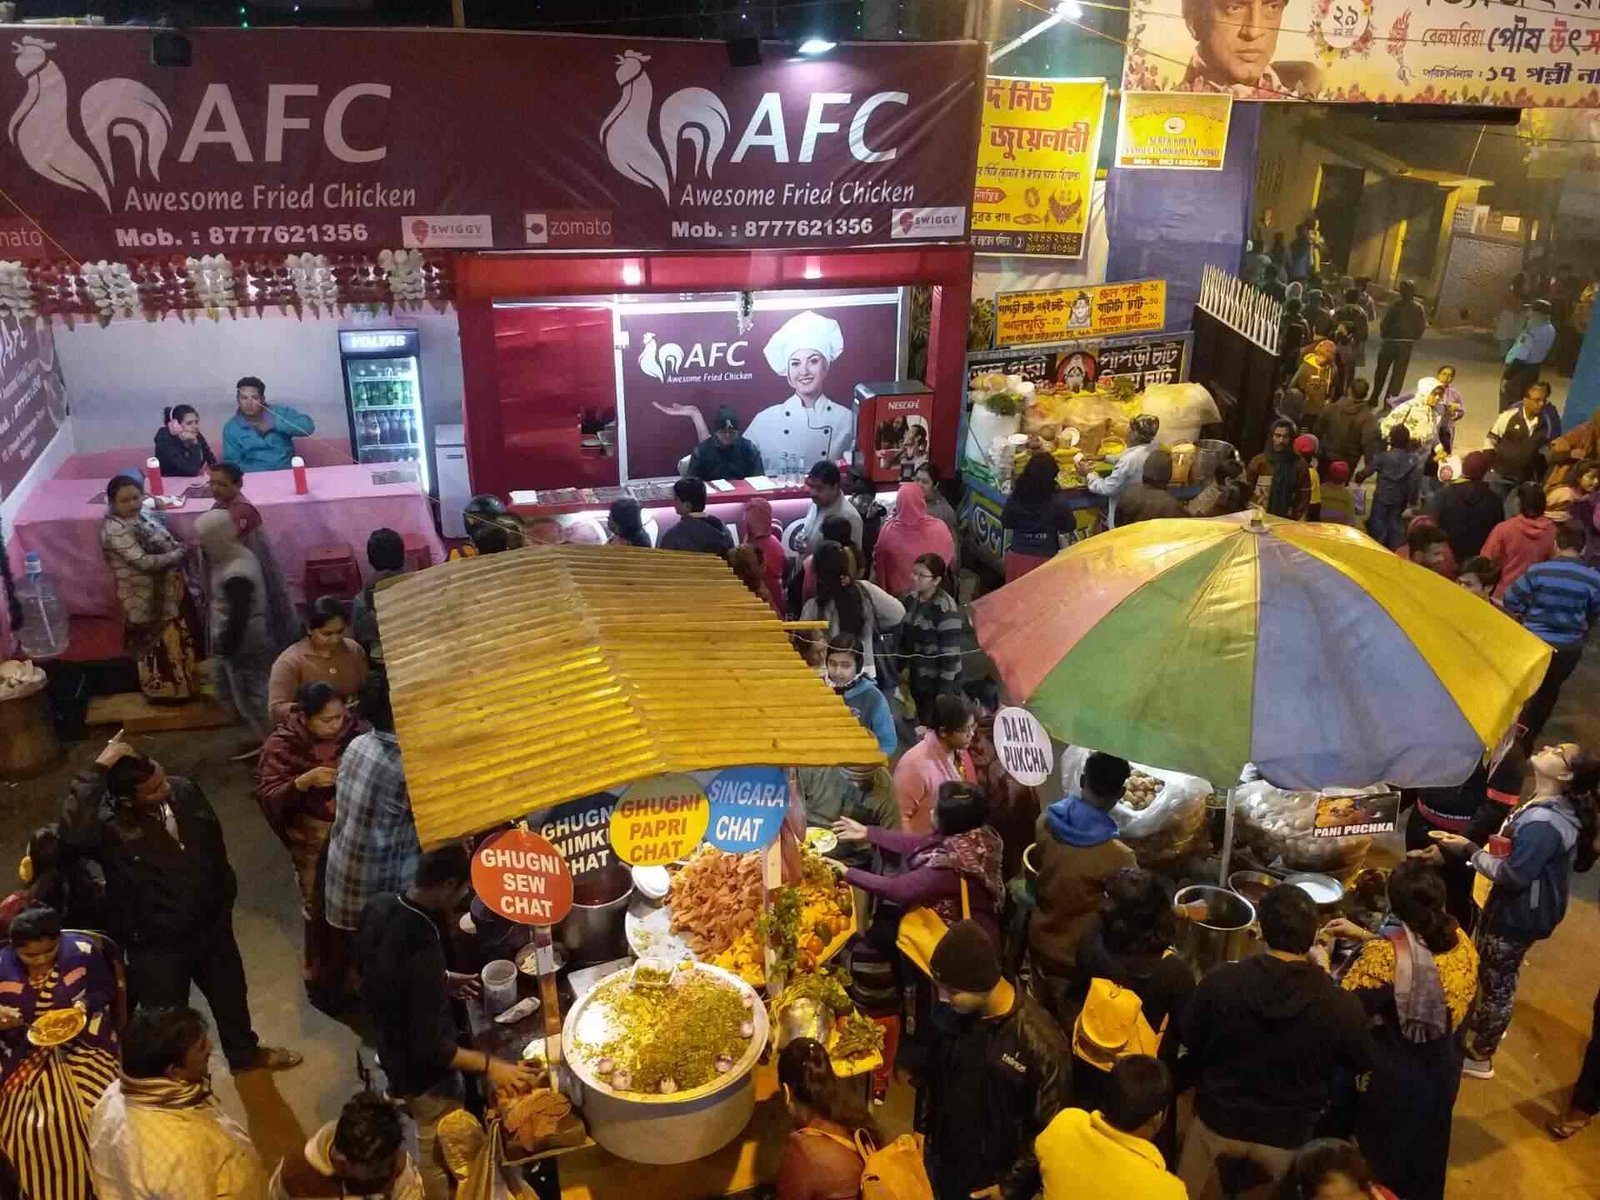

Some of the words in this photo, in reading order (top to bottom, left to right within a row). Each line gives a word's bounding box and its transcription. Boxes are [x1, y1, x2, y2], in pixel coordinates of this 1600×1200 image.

[1333, 5, 1359, 26] ২৯
[1423, 21, 1486, 48] বেলঘরিয়া
[1488, 15, 1545, 53] পৌষ
[1485, 66, 1516, 82] ১৭
[1526, 62, 1572, 85] পল্লী
[1009, 80, 1055, 111] নিউ
[178, 83, 392, 163] AFC
[730, 91, 909, 164] AFC
[990, 121, 1090, 161] জুয়েলারী
[124, 186, 244, 212] Awesome
[254, 184, 314, 210] Fried
[324, 183, 416, 208] Chicken
[680, 183, 775, 207] Awesome
[782, 183, 833, 206] Fried
[839, 181, 914, 204] Chicken
[431, 224, 482, 234] SWIGGY
[550, 219, 612, 236] zomato
[672, 220, 723, 238] Mob.
[745, 218, 872, 237] 8777621356
[914, 215, 958, 225] SWIGGY
[116, 227, 183, 247] Mob.
[209, 223, 369, 244] 8777621356
[351, 336, 406, 347] VOLTAS
[684, 341, 749, 368] AFC
[1099, 347, 1150, 370] পাপড়ী
[667, 374, 702, 384] Awesome
[703, 373, 723, 382] Fried
[724, 372, 753, 381] Chicken
[1001, 716, 1034, 743] DAHI
[1003, 746, 1049, 773] PUKCHA
[709, 779, 786, 808] SINGARA
[620, 794, 700, 818] GHUGNI
[541, 804, 613, 840] GHUGN
[629, 818, 687, 840] PAPRI
[716, 815, 763, 842] CHAT
[1314, 827, 1342, 837] PANI
[1344, 822, 1394, 835] PUCHKA
[480, 848, 560, 875] GHUGNI
[566, 849, 610, 876] HAT
[630, 841, 683, 863] CHAT
[503, 873, 546, 894] SEW
[500, 895, 552, 917] CHAT
